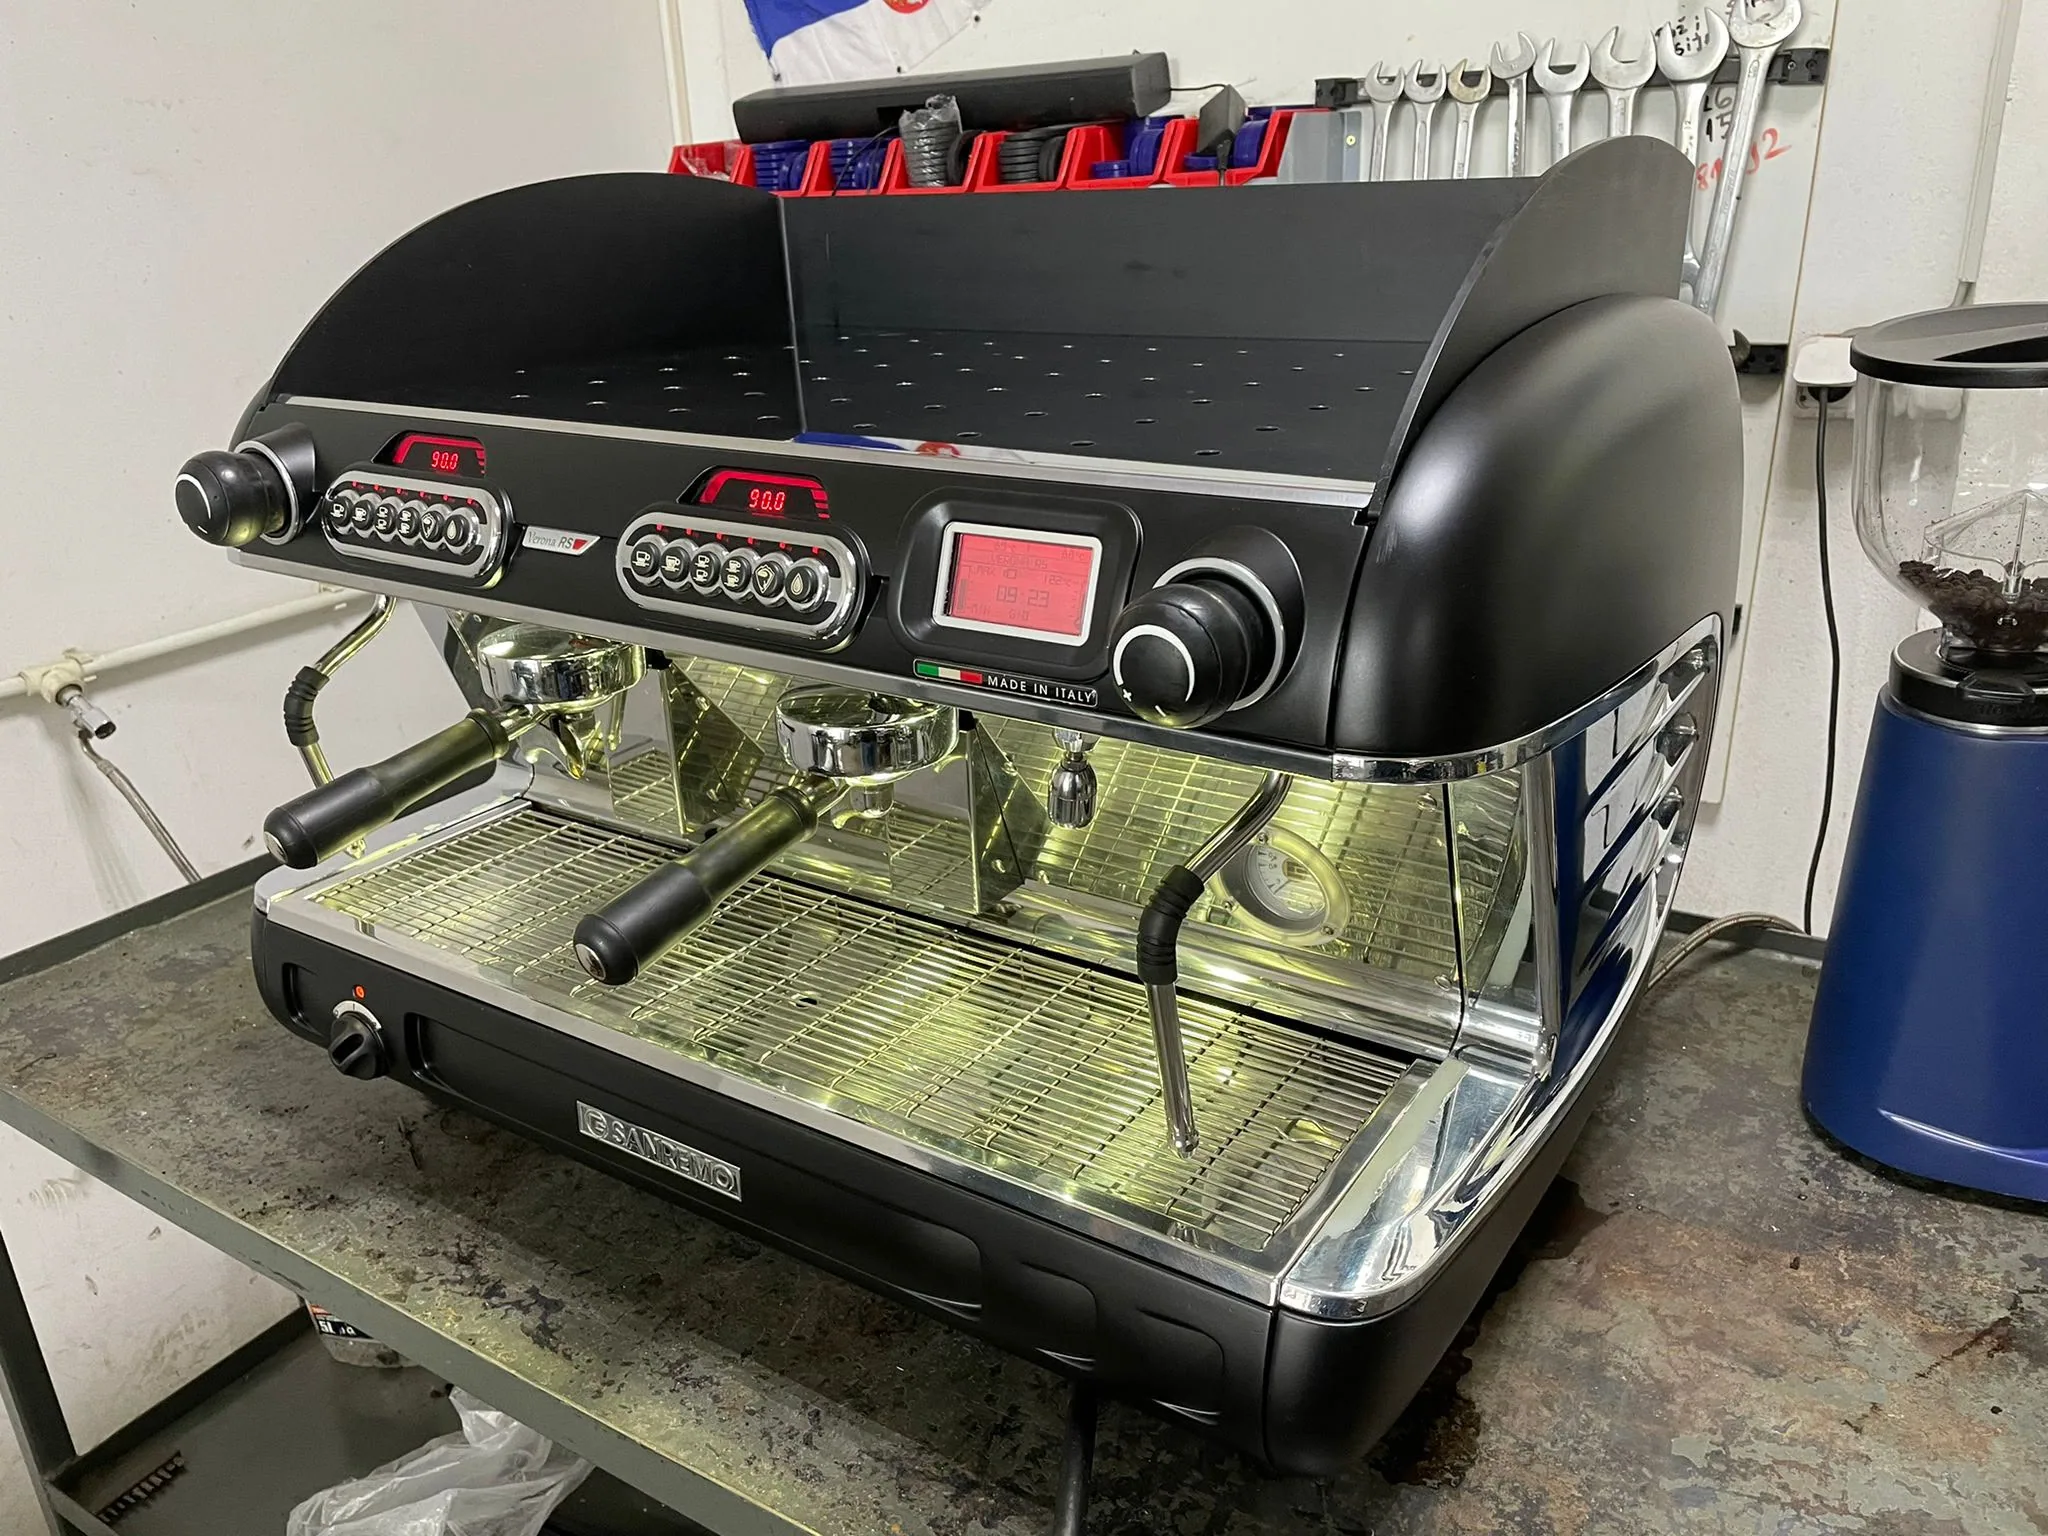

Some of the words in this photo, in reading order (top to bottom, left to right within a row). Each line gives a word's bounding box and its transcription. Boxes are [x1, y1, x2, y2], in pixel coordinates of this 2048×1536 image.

[431, 450, 459, 470] 90.0
[749, 488, 786, 511] 90.0
[528, 531, 556, 546] Verona
[557, 536, 574, 550] RS
[987, 674, 1027, 692] MADE
[1033, 683, 1049, 696] IN
[1055, 686, 1094, 703] ITALY
[611, 1119, 736, 1192] SANREMO
